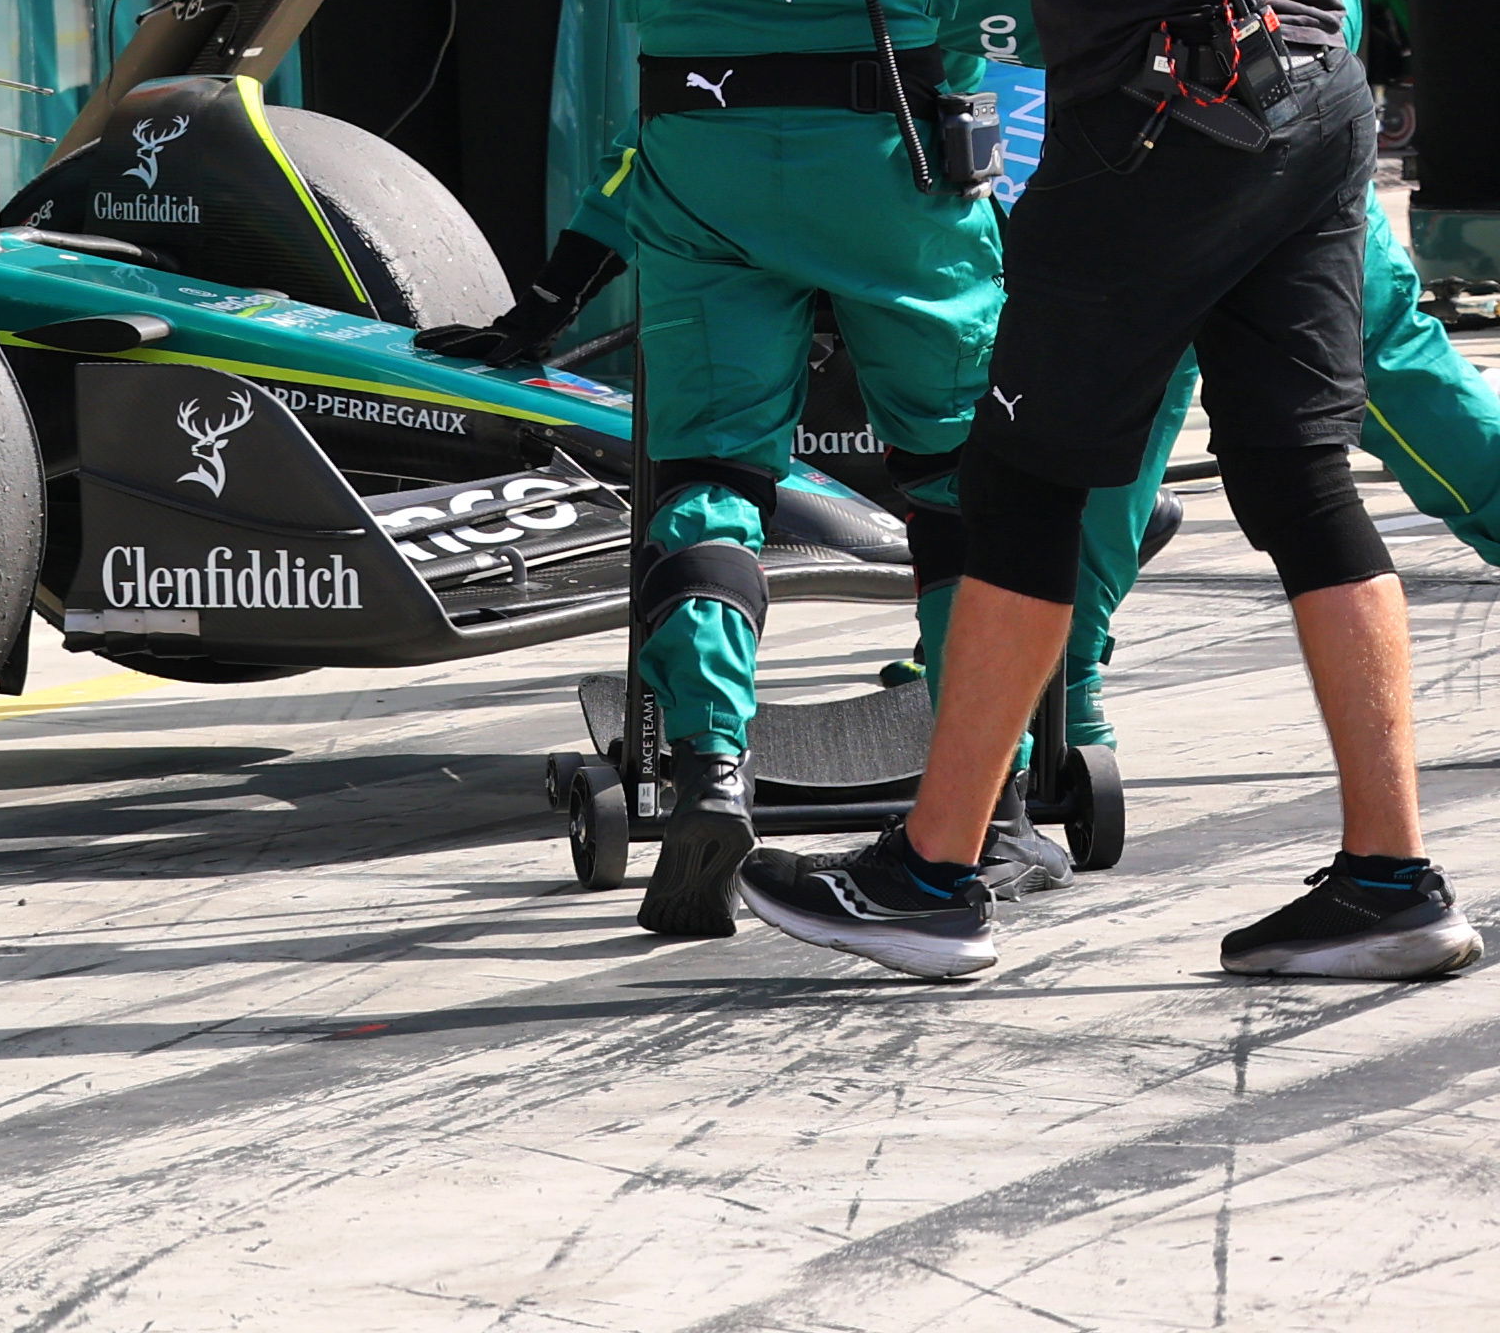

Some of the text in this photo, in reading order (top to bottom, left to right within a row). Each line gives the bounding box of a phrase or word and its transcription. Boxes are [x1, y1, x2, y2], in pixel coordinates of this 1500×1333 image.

[993, 83, 1048, 207] RTIN
[93, 191, 201, 226] Glenfiddich
[101, 544, 364, 612] Glenfiddich
[642, 704, 656, 735] TEAM
[642, 738, 654, 774] RACE
